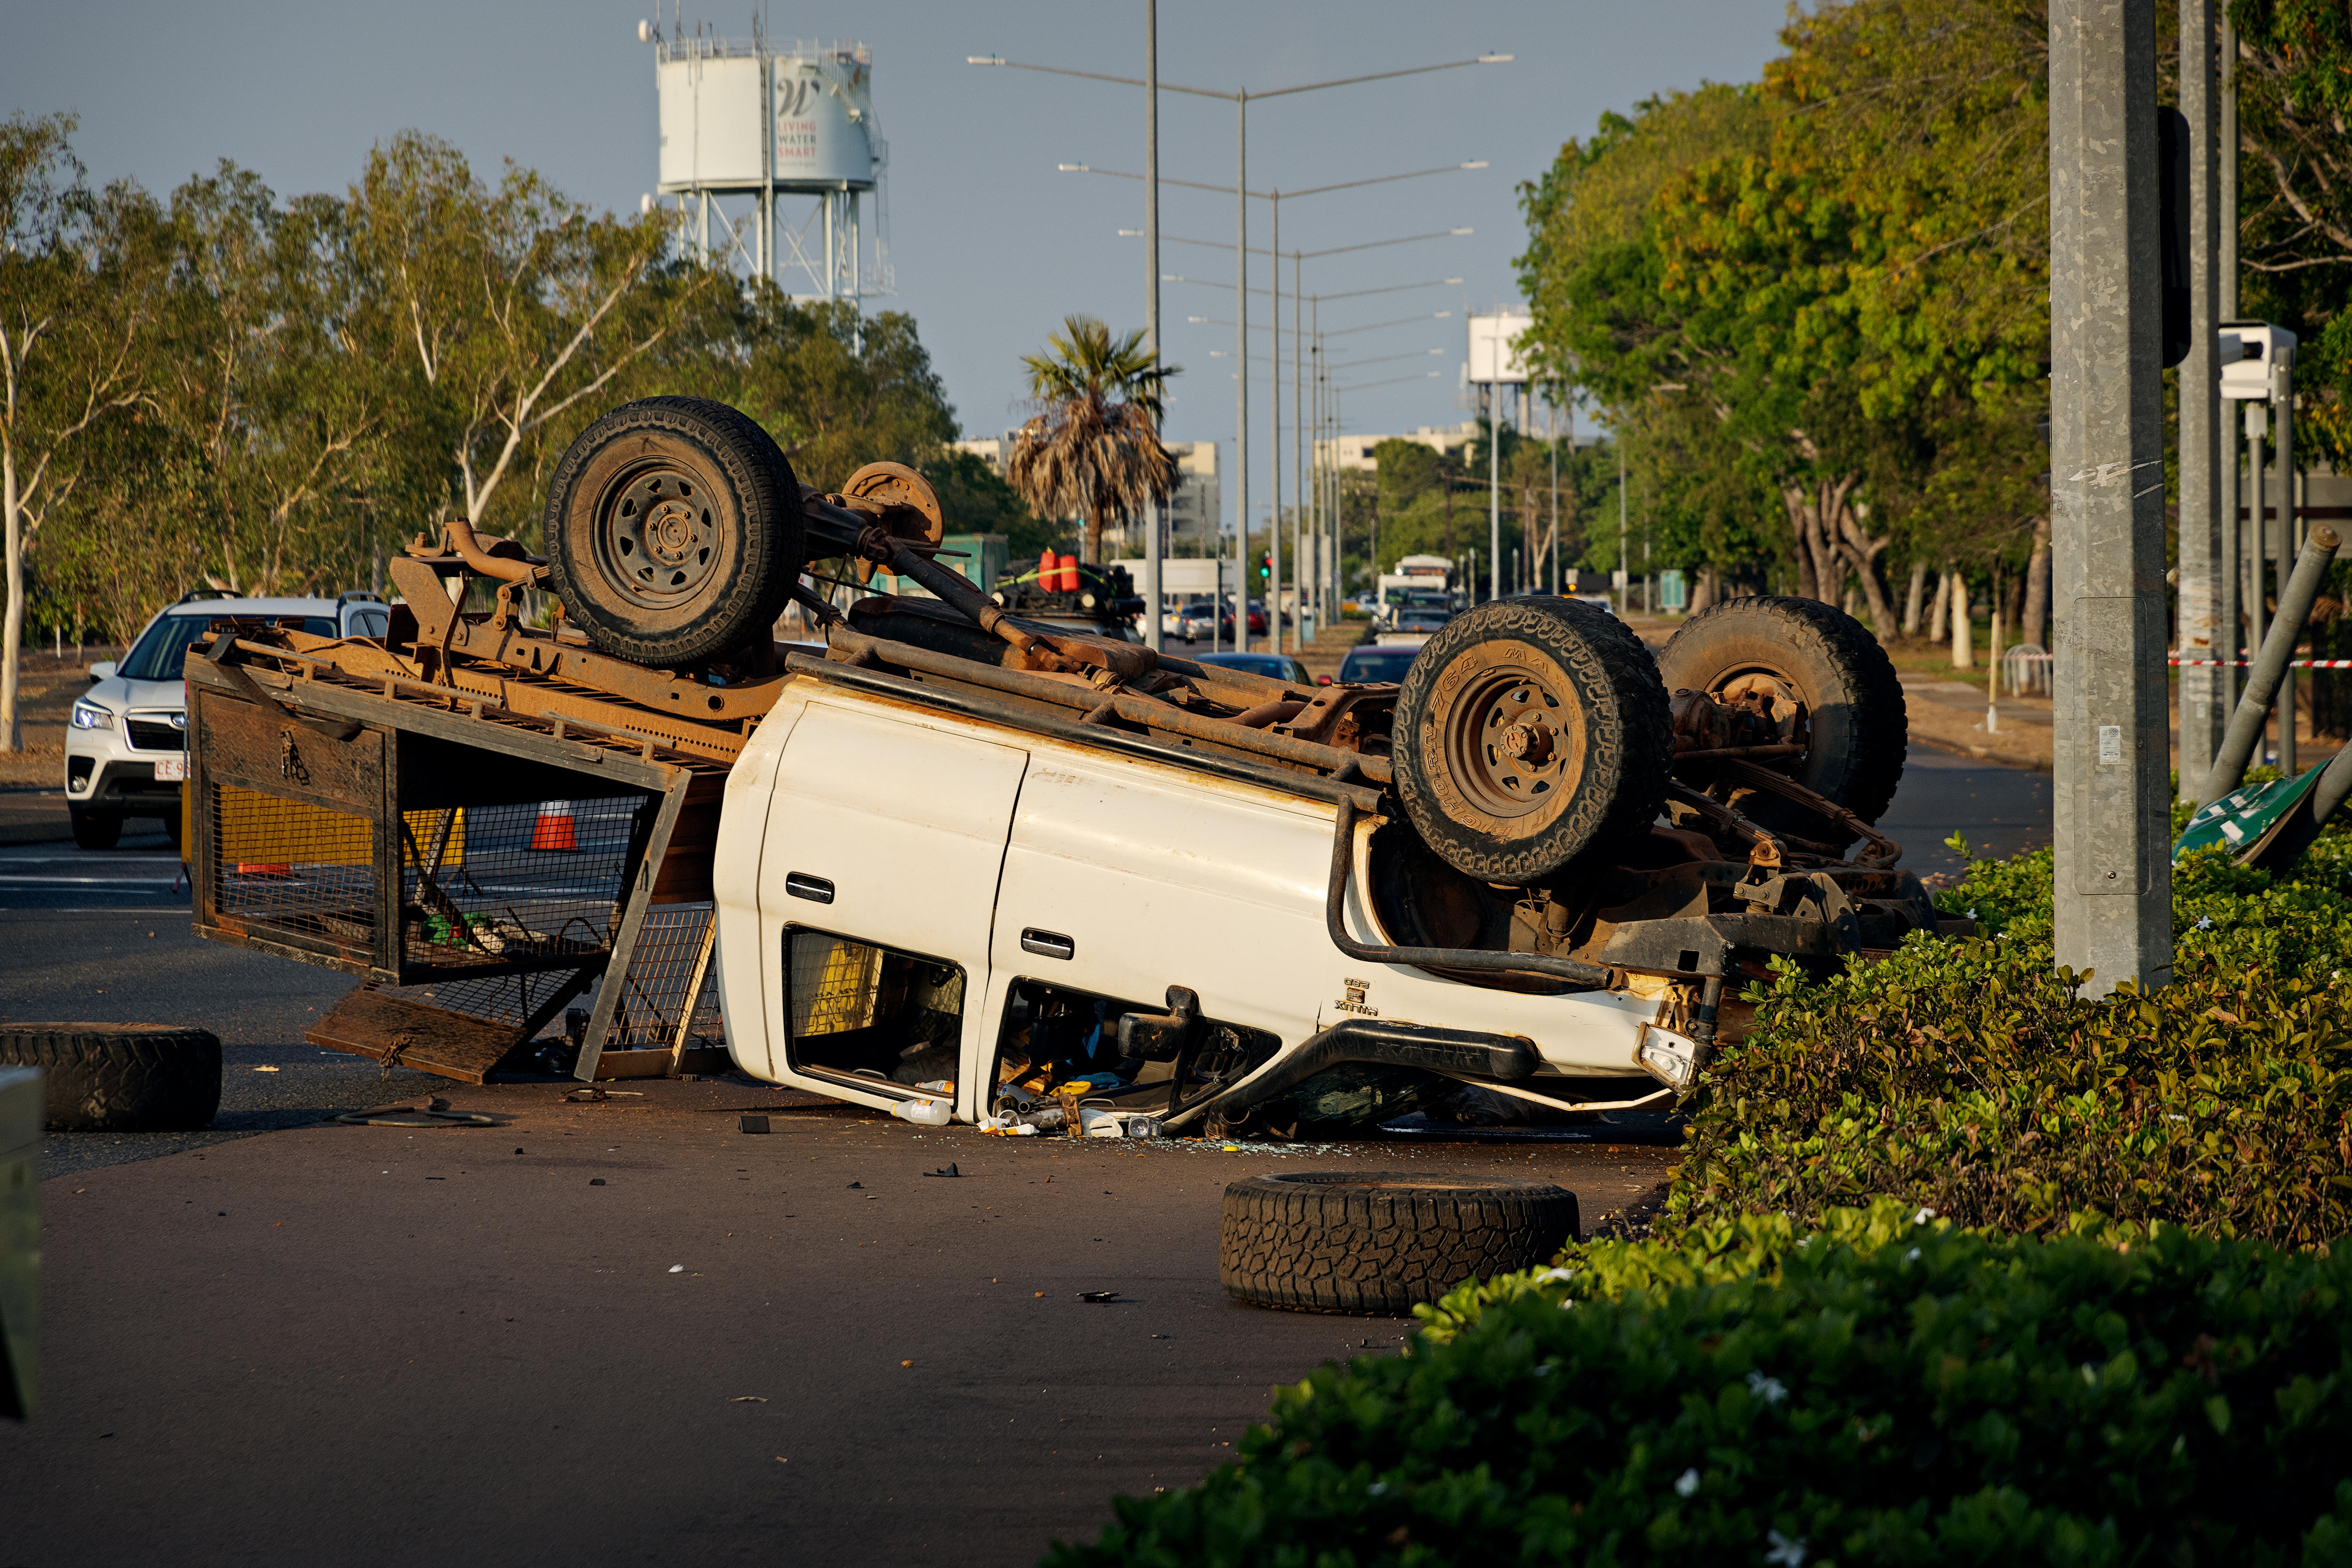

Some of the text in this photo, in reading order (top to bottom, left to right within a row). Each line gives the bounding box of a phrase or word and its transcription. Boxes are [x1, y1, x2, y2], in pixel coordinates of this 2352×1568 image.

[778, 121, 816, 132] LIVING
[779, 135, 816, 144] WATER
[778, 147, 816, 158] SMART
[1503, 647, 1582, 828] MAXXIS M/T
[1424, 654, 1514, 836] BIGHORN 764
[1344, 978, 1369, 989] 2.8D
[1334, 1000, 1377, 1016] HILUX
